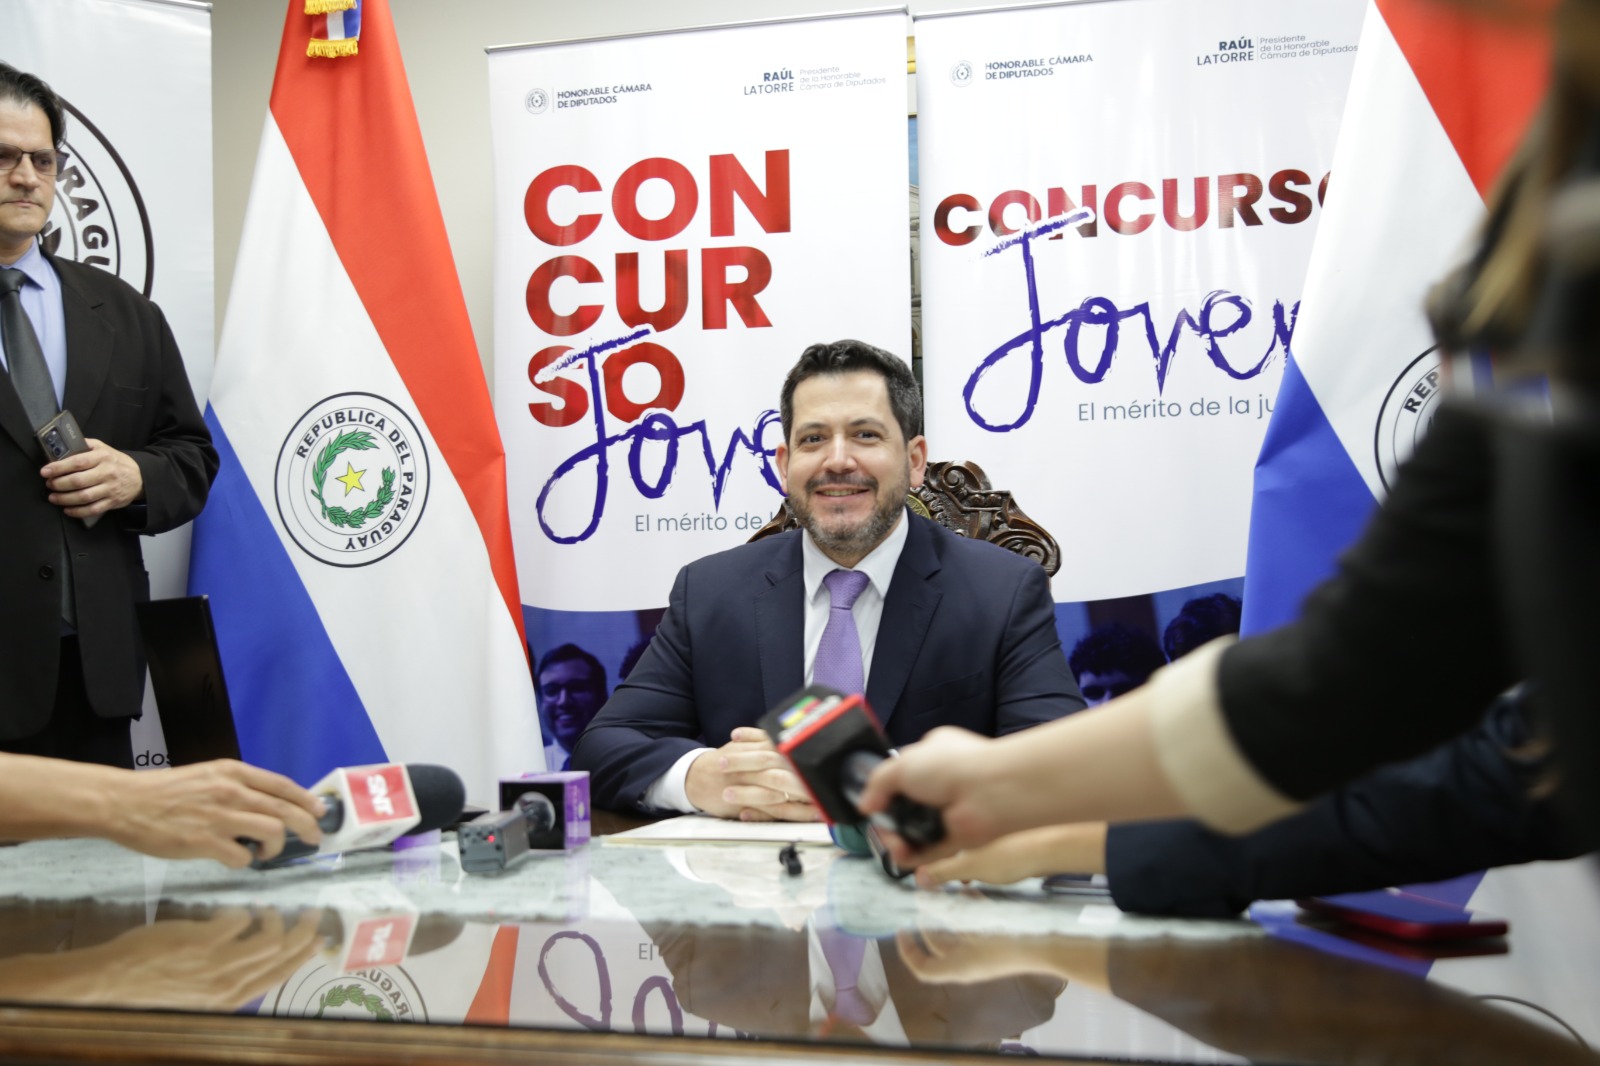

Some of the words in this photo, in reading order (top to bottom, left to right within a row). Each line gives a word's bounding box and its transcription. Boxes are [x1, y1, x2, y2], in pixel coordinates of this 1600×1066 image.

[1219, 36, 1254, 51] RAÚL
[1260, 35, 1306, 44] Presidente
[1260, 44, 1271, 52] de
[1273, 44, 1281, 52] la
[1284, 39, 1330, 50] Honorable
[1197, 51, 1254, 66] LATORRE
[1260, 50, 1297, 60] Cámara
[1299, 48, 1310, 57] de
[1312, 45, 1358, 57] Diputados
[985, 58, 1045, 70] HONORABLE
[1049, 54, 1093, 66] CÁMARA
[763, 67, 794, 82] RAÚL
[800, 66, 840, 75] Presidente
[821, 71, 861, 81] Honorable
[985, 71, 998, 80] DE
[999, 67, 1054, 79] DIPUTADOS
[557, 87, 610, 99] HONORABLE
[612, 83, 652, 94] CÁMARA
[744, 82, 794, 96] LATORRE
[557, 100, 569, 109] DE
[570, 95, 617, 108] DIPUTADOS
[524, 149, 791, 247] CON
[526, 246, 773, 337] CUR
[528, 342, 685, 427] SO
[1078, 402, 1094, 421] El
[1103, 399, 1182, 420] mérito
[1189, 397, 1221, 416] de
[1229, 396, 1250, 415] la
[296, 410, 386, 459] REPUBLICA
[388, 429, 410, 465] DEL
[345, 472, 414, 550] PARAGUAY
[635, 514, 650, 532] El
[657, 512, 728, 531] mérito
[734, 512, 762, 530] de
[366, 774, 394, 816] SNT
